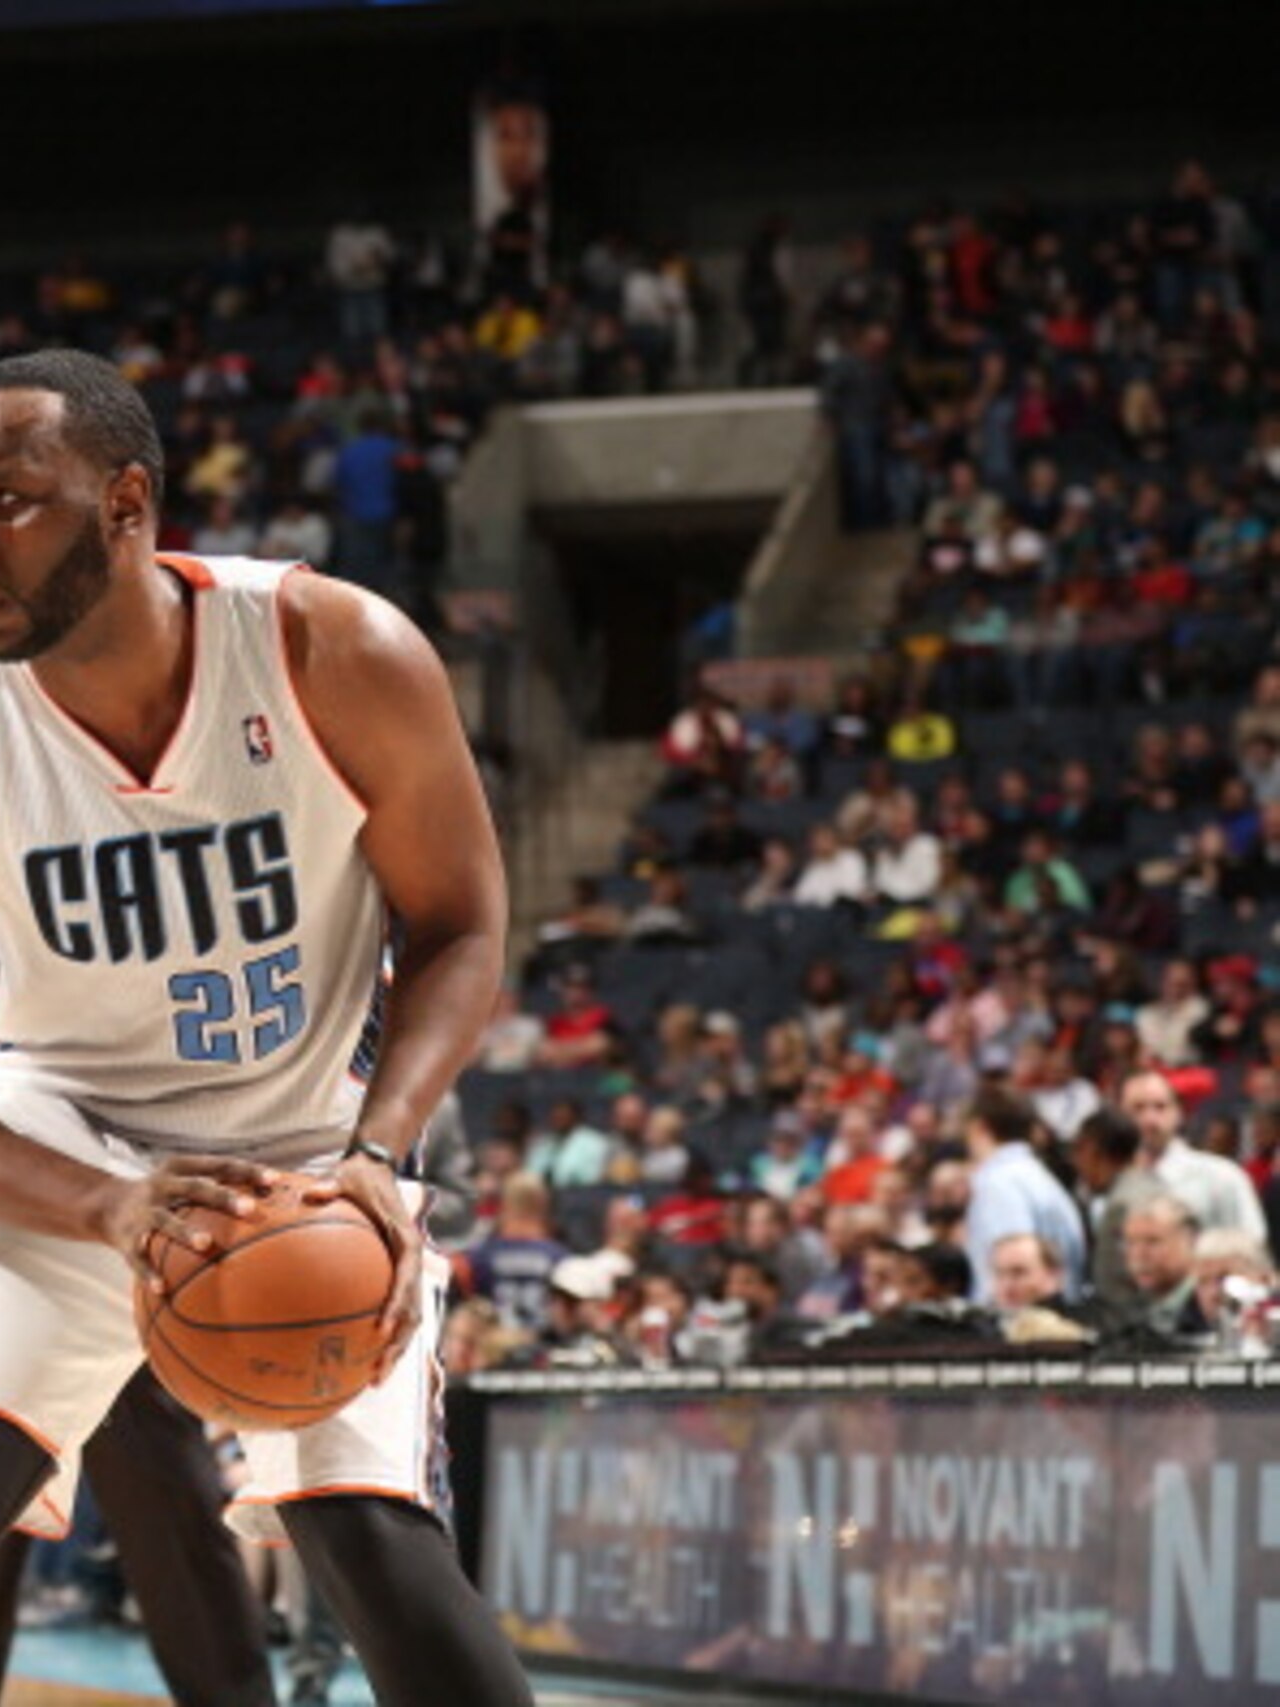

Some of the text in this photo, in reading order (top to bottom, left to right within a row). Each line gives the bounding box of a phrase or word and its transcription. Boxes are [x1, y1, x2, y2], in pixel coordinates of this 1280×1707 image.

[24, 810, 298, 965] CATS
[168, 944, 307, 1063] 25
[891, 1451, 1091, 1549] NOVANT
